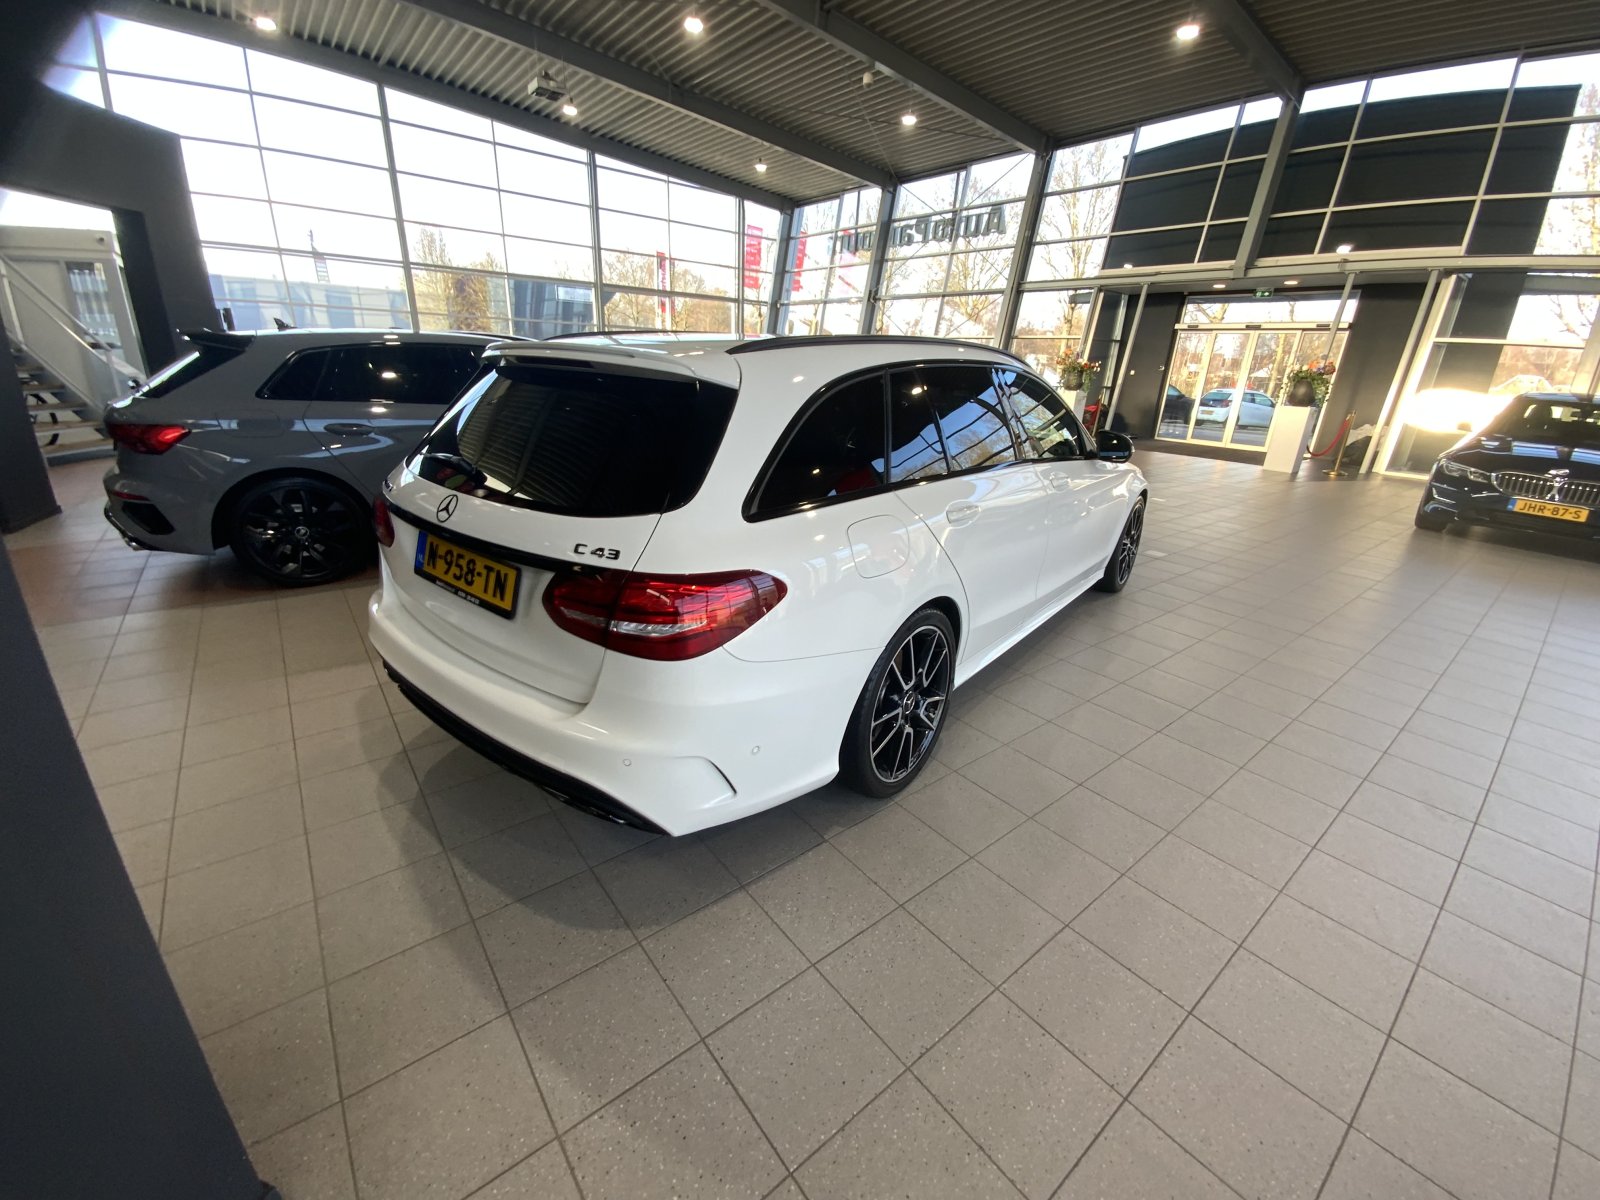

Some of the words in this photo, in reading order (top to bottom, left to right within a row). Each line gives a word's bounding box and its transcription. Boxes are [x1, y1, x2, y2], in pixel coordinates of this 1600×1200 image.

[1519, 502, 1582, 519] JHR-87-S
[573, 543, 588, 555] C
[590, 547, 620, 560] 43
[427, 541, 508, 602] N-958-TN
